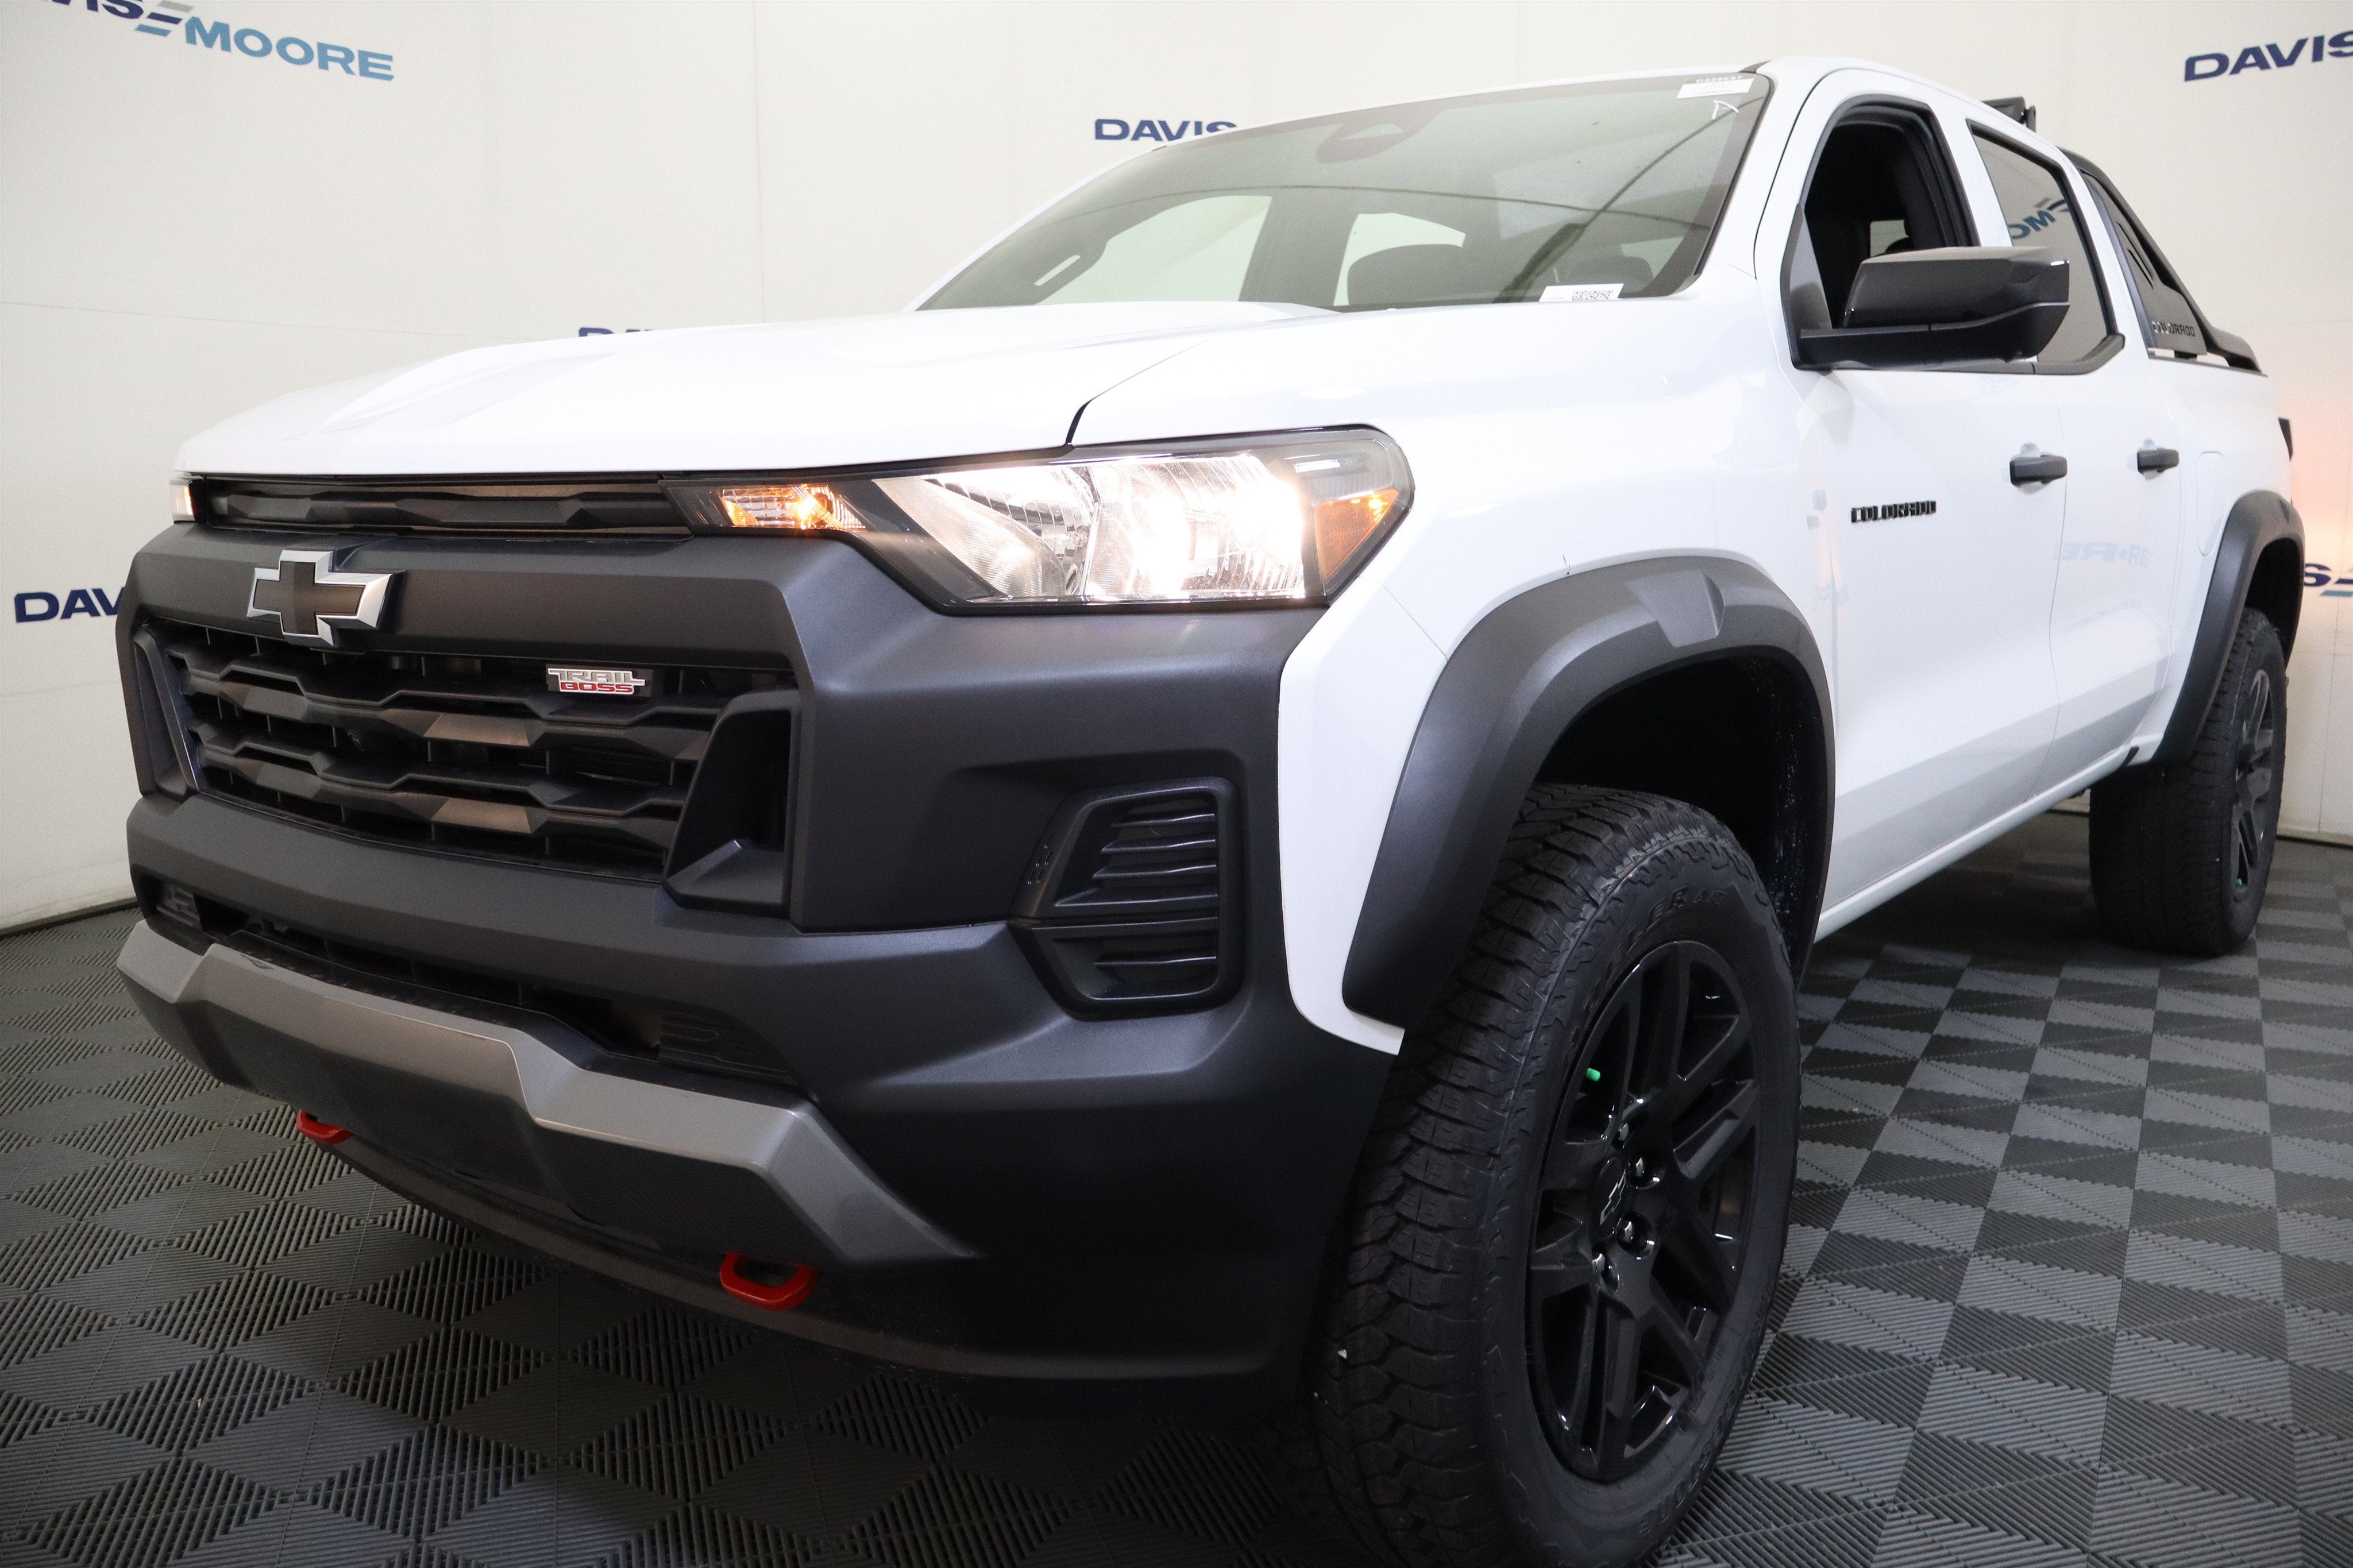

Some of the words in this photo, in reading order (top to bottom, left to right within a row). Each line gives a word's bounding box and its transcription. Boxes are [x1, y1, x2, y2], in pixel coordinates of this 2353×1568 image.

[184, 16, 394, 82] MOORE
[2151, 320, 2196, 337] COLORADO
[1851, 500, 1937, 523] COLORADO
[548, 668, 645, 685] TRAIL
[560, 681, 635, 694] BOSS
